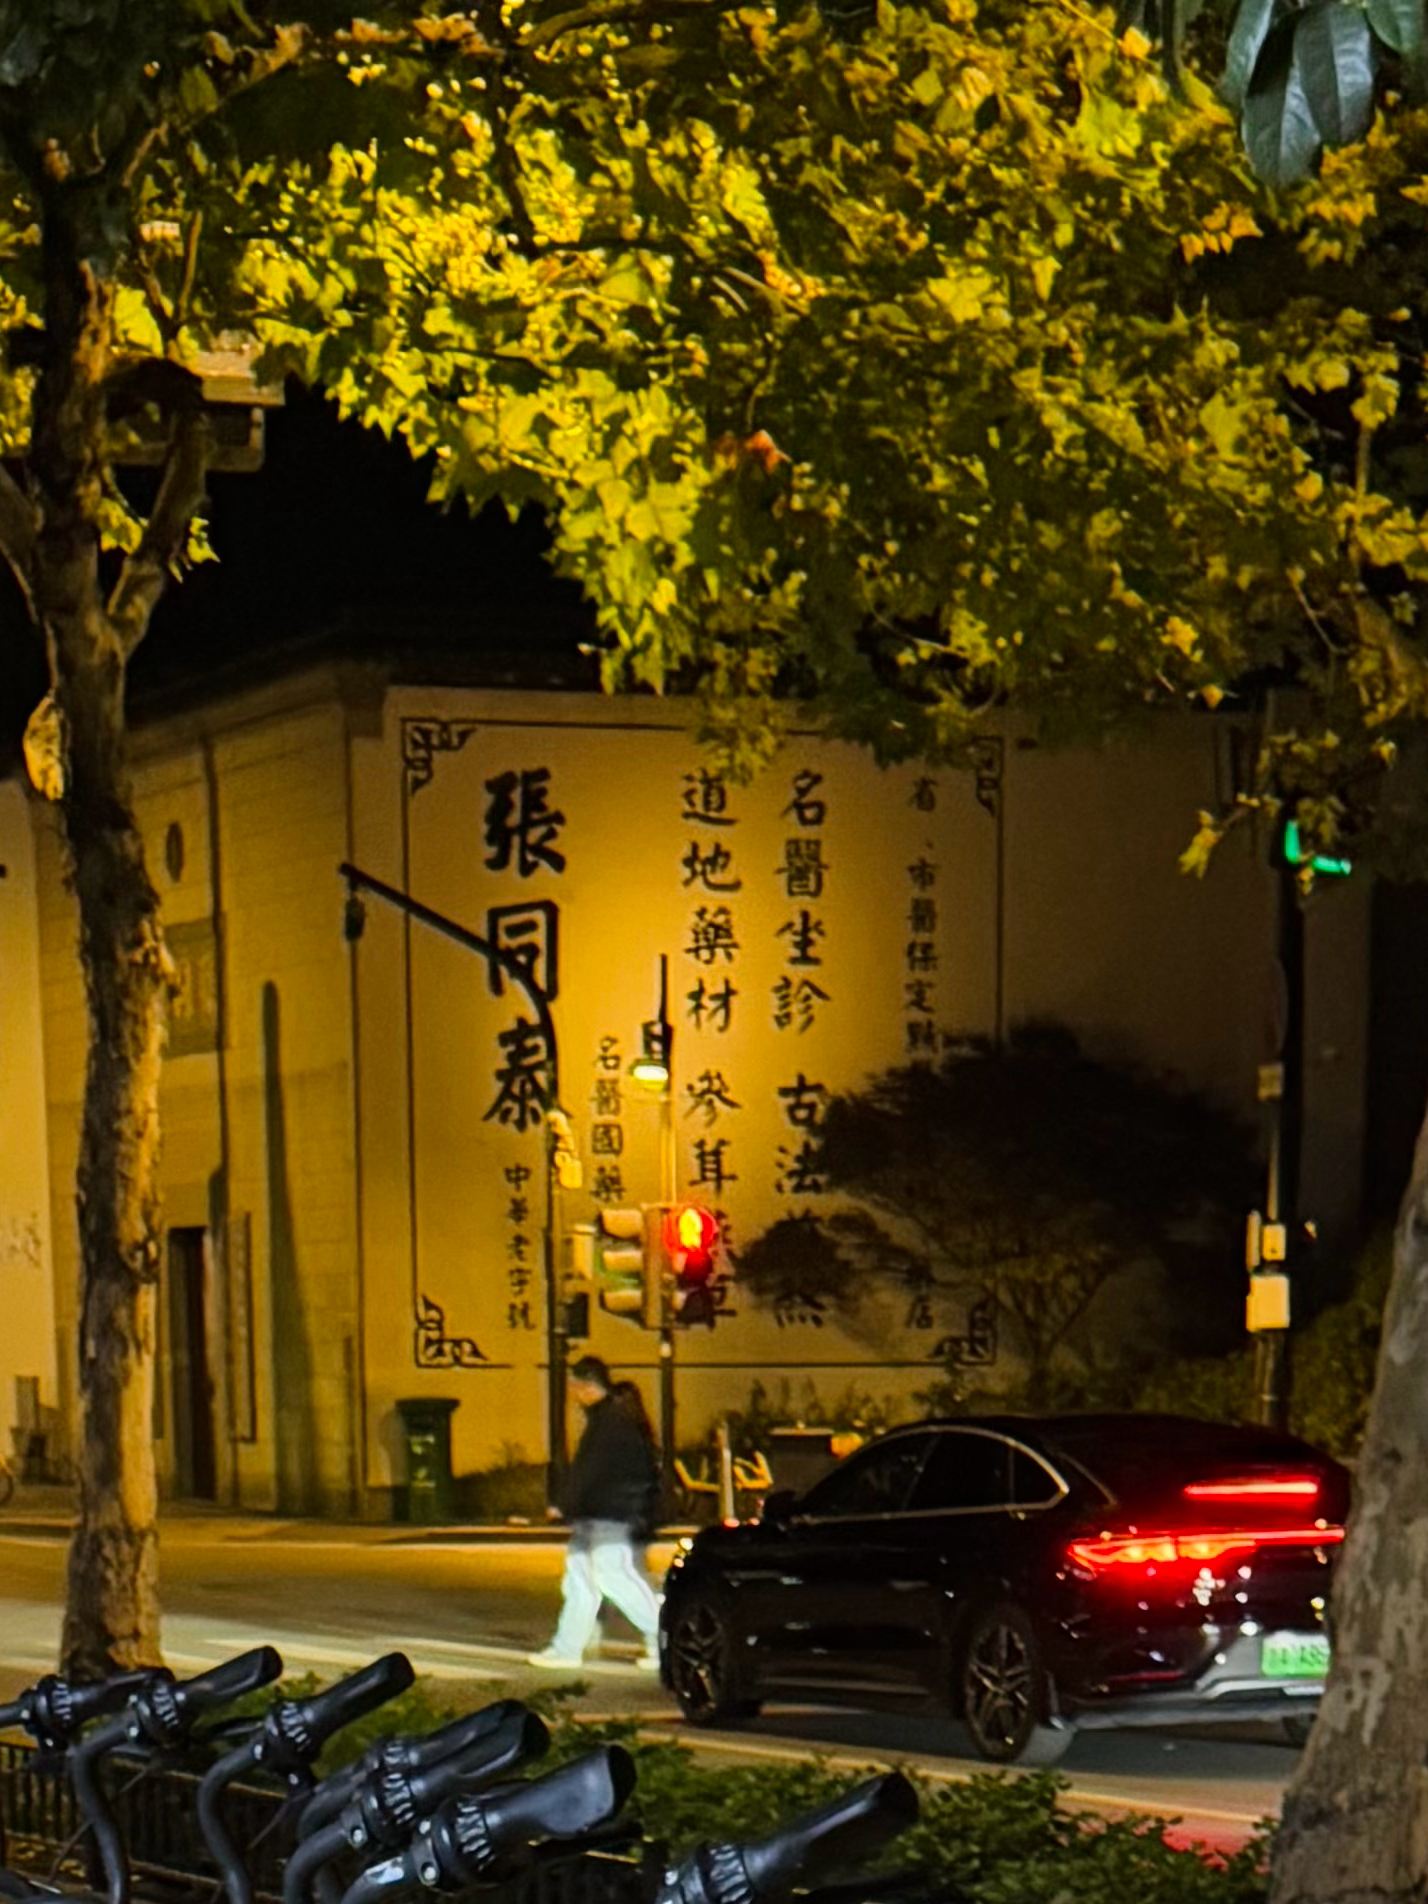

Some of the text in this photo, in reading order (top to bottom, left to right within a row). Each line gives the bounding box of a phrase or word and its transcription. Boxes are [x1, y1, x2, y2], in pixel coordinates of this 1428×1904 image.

[482, 767, 571, 1135] 張同泰
[680, 771, 742, 1032] 道地藥材
[772, 769, 832, 1034] 名醫坐診
